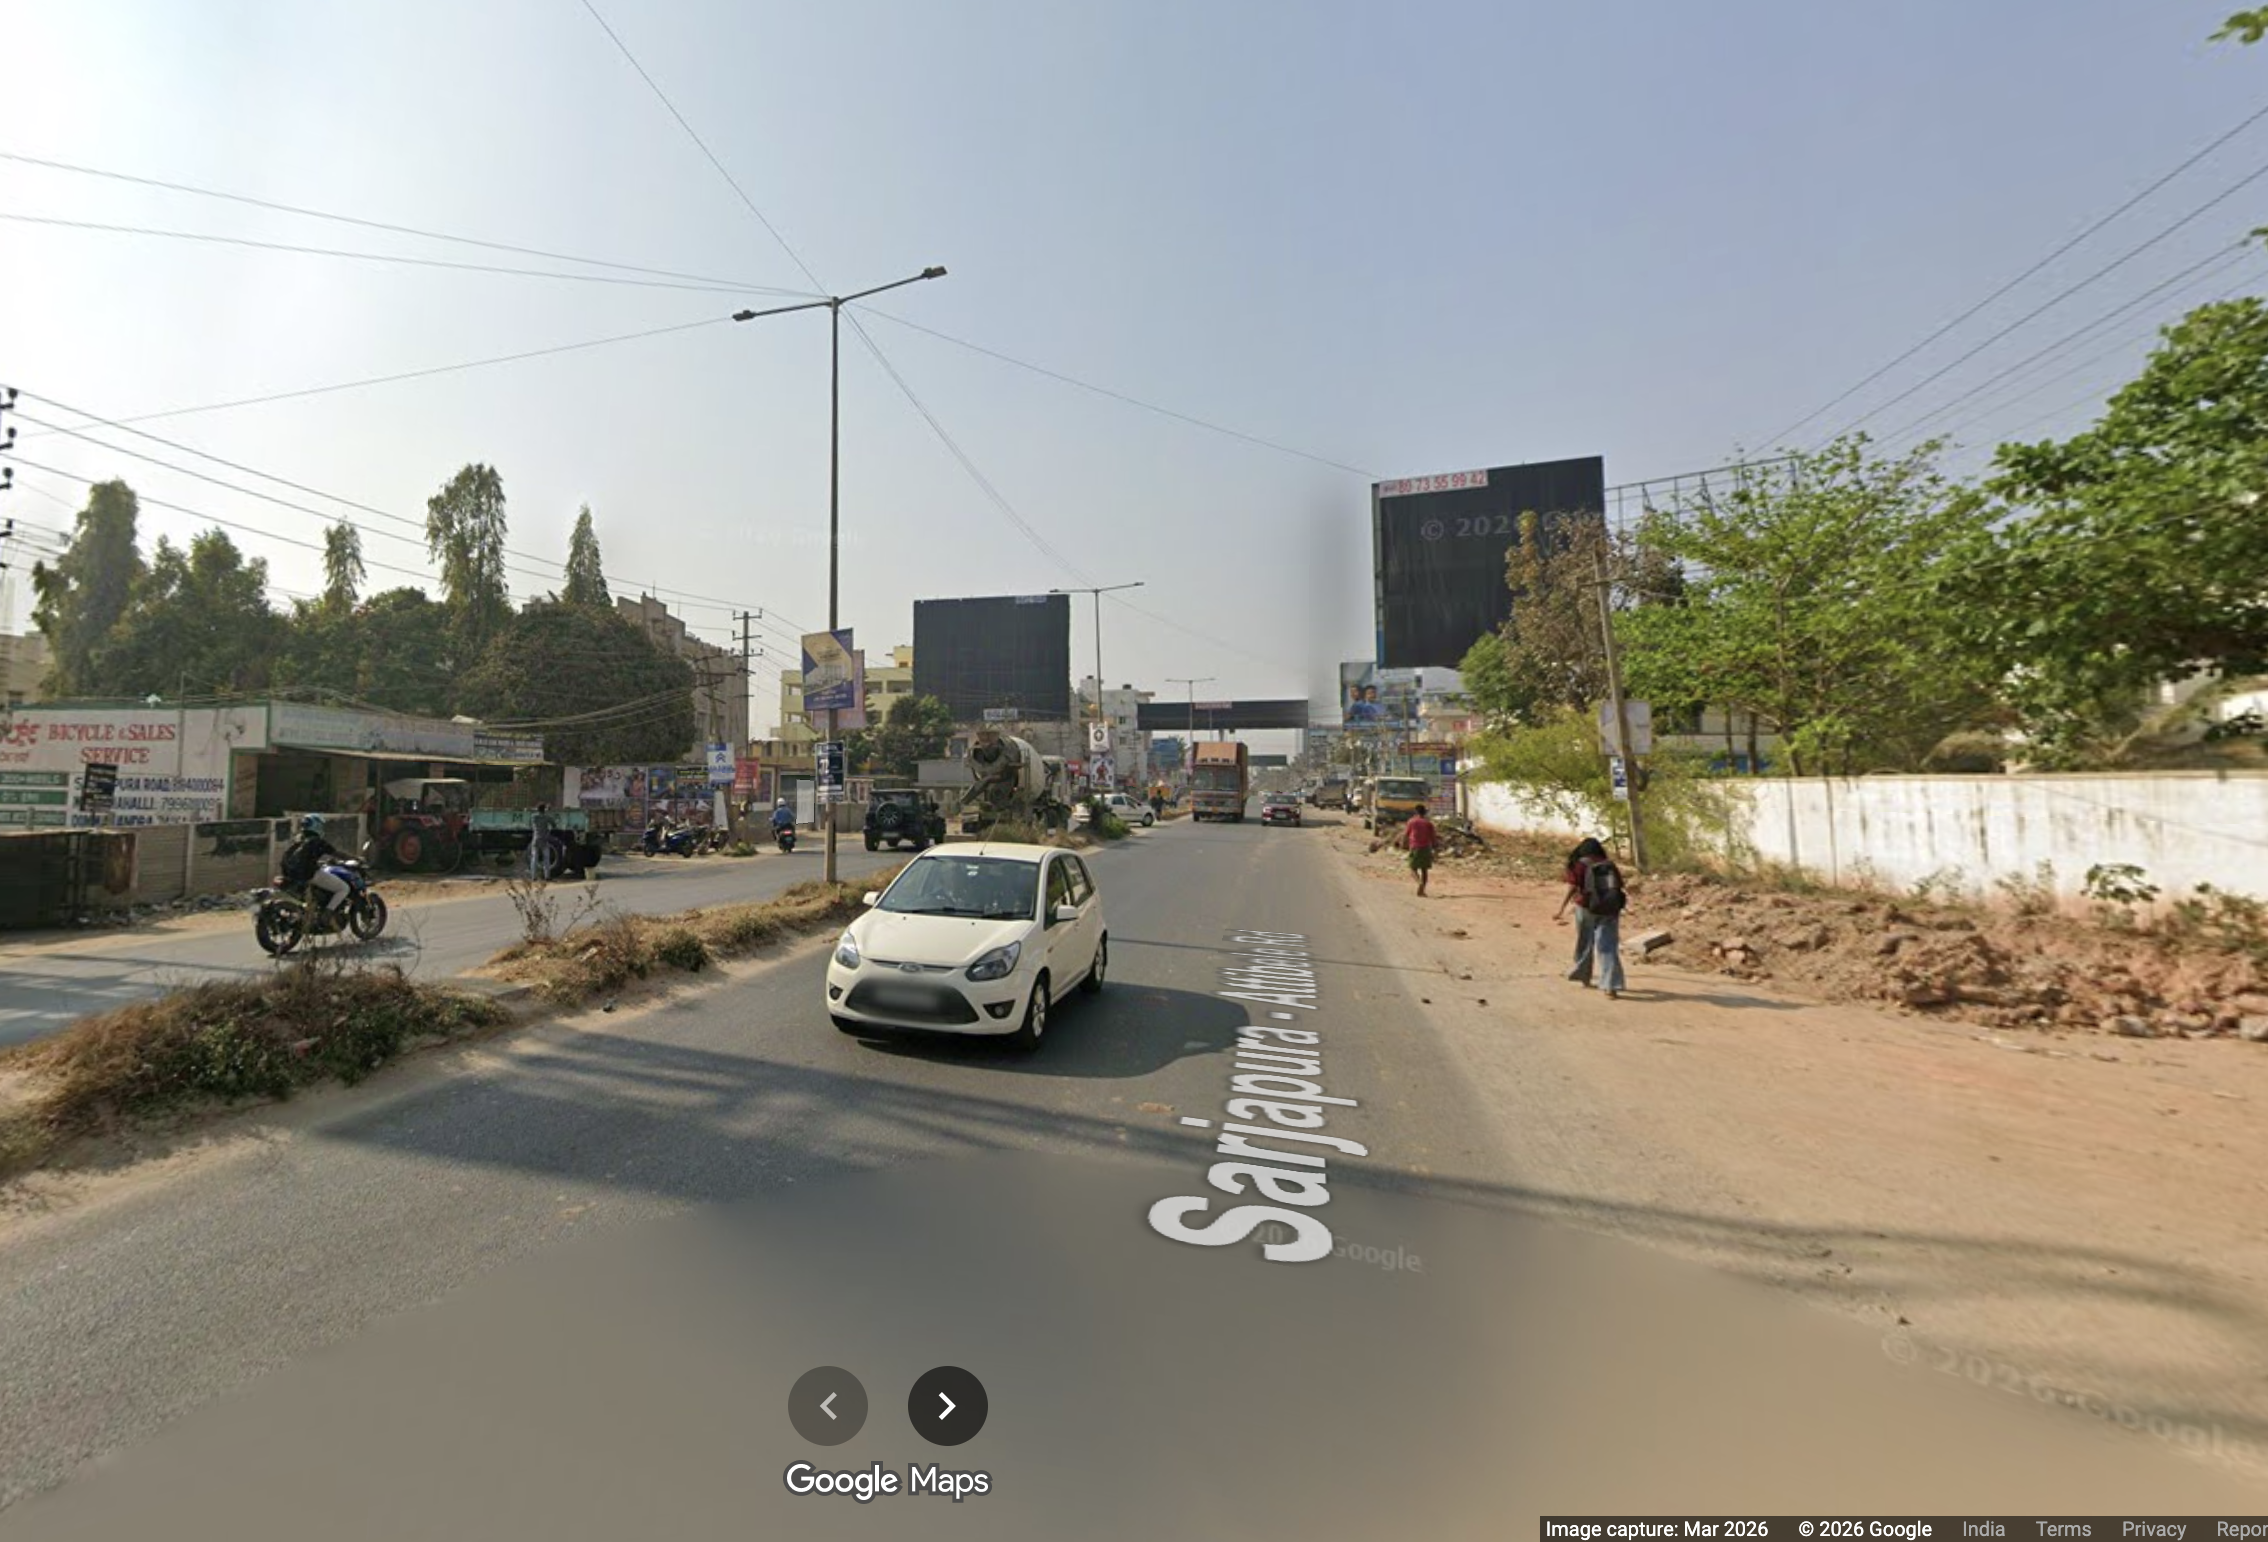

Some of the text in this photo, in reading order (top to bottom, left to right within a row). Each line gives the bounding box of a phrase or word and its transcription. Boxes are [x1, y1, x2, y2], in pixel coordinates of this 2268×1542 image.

[1416, 476, 1430, 491] 73
[1434, 474, 1448, 489] 55
[1452, 472, 1466, 486] 99
[48, 723, 114, 741] BICYCLE
[128, 723, 176, 741] SALES
[80, 746, 149, 764] SERVICE
